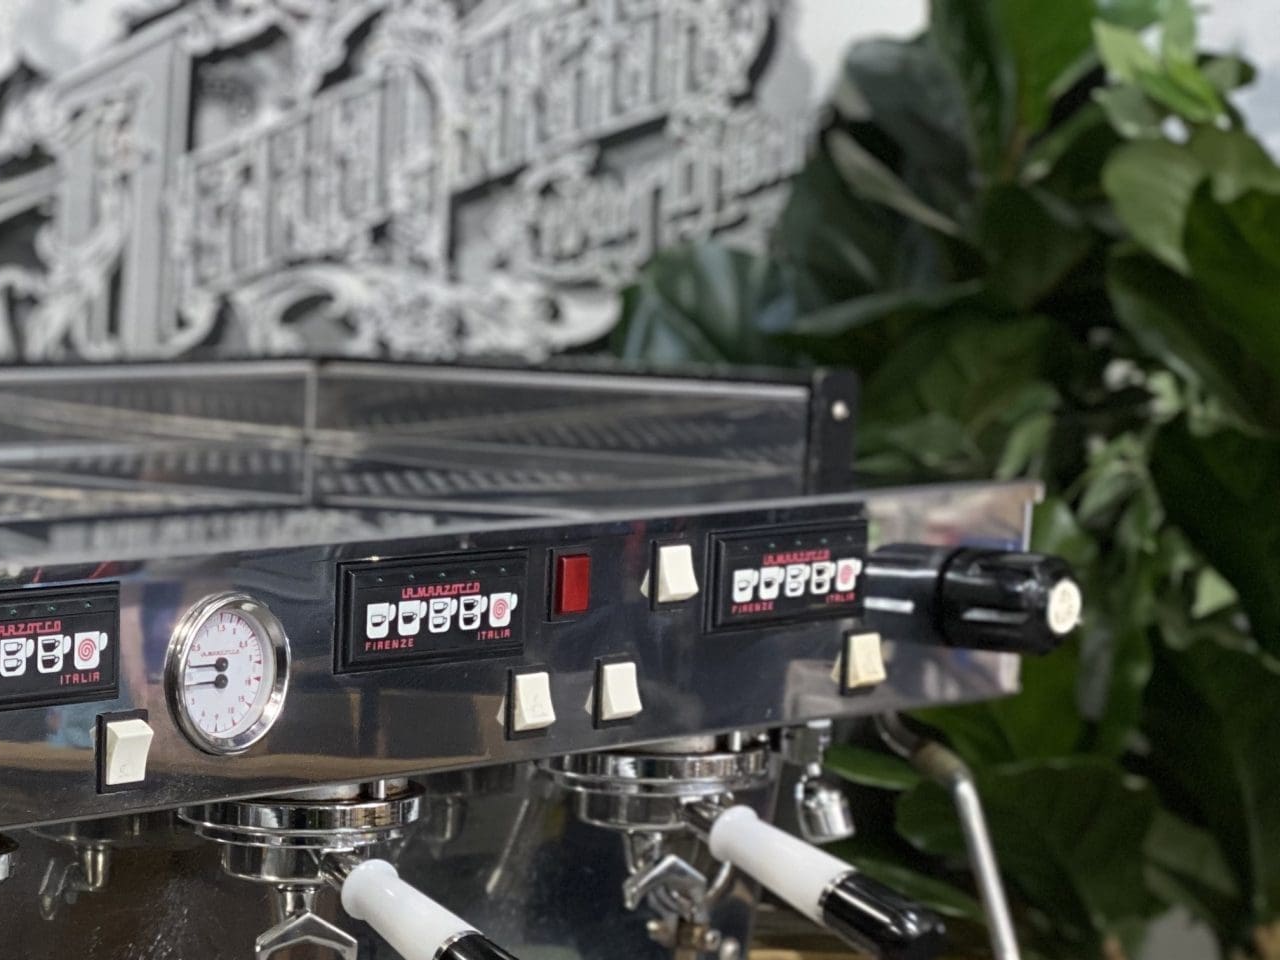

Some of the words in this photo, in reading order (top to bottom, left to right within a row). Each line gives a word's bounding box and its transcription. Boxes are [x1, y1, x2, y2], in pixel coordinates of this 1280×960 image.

[477, 628, 511, 641] ITALIA
[365, 638, 415, 651] FIRENZE
[60, 672, 100, 686] ITALIA
